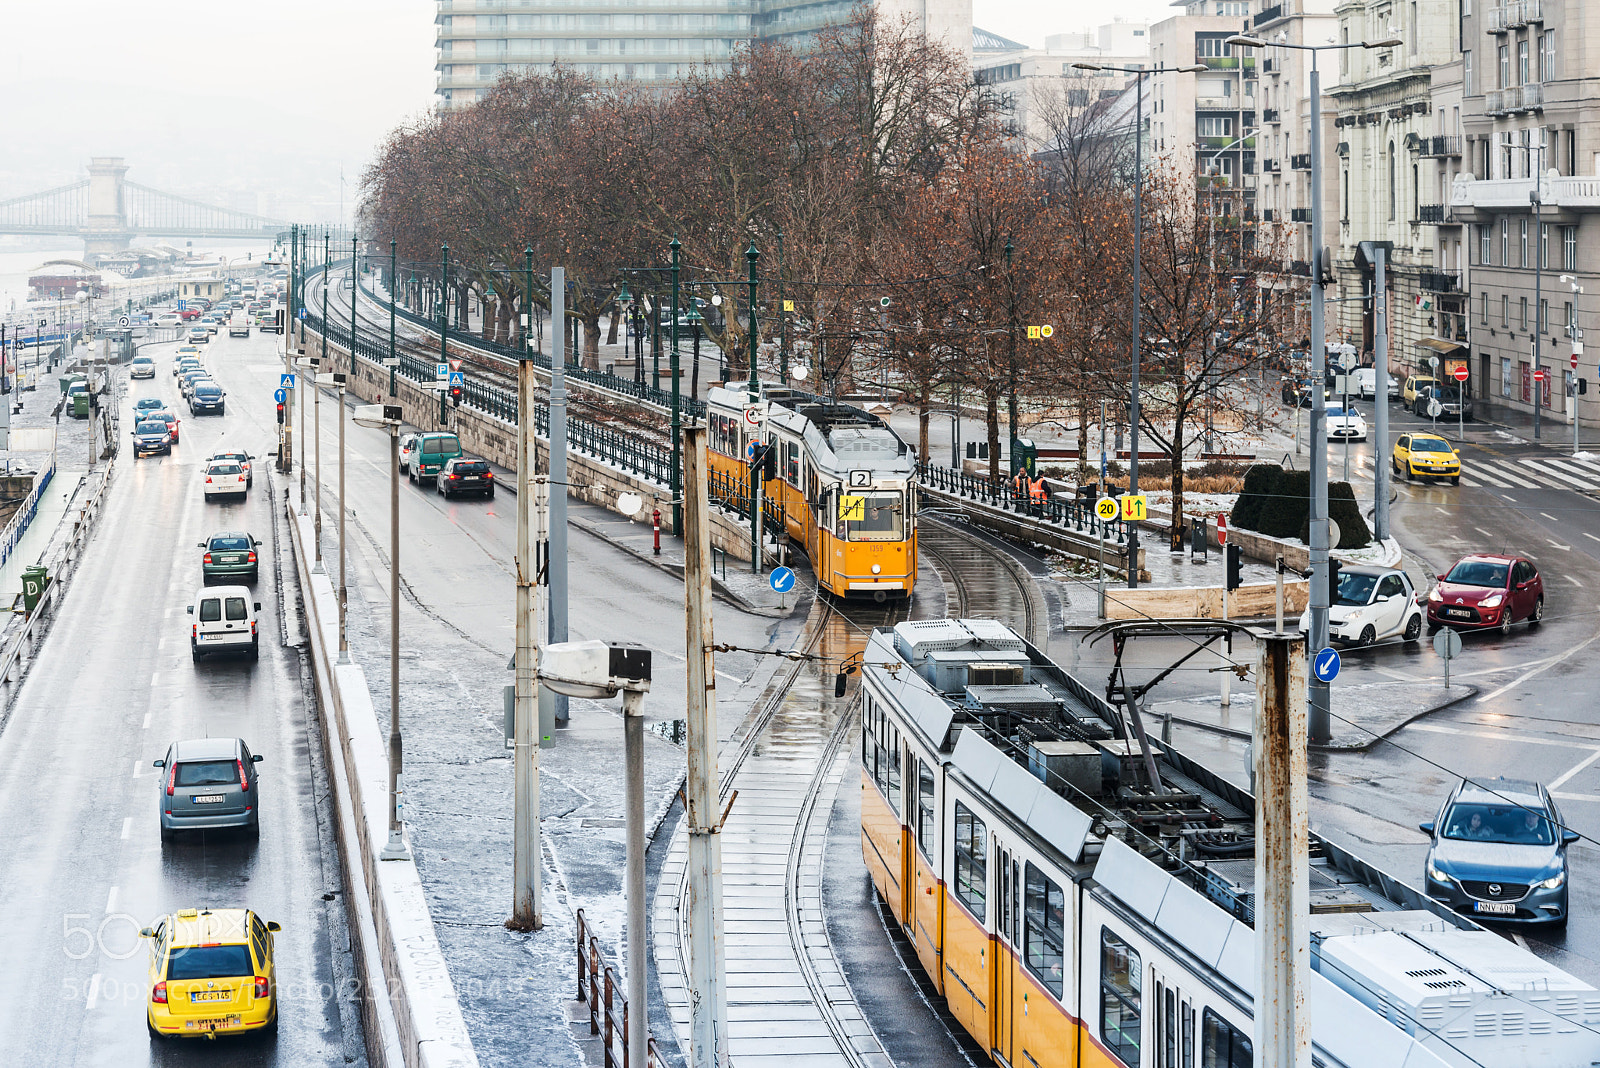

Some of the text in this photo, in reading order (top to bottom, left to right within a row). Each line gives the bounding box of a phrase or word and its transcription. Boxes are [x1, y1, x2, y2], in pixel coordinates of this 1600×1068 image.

[857, 474, 866, 486] 2
[1100, 504, 1114, 514] 20
[196, 991, 230, 1001] ECS-145
